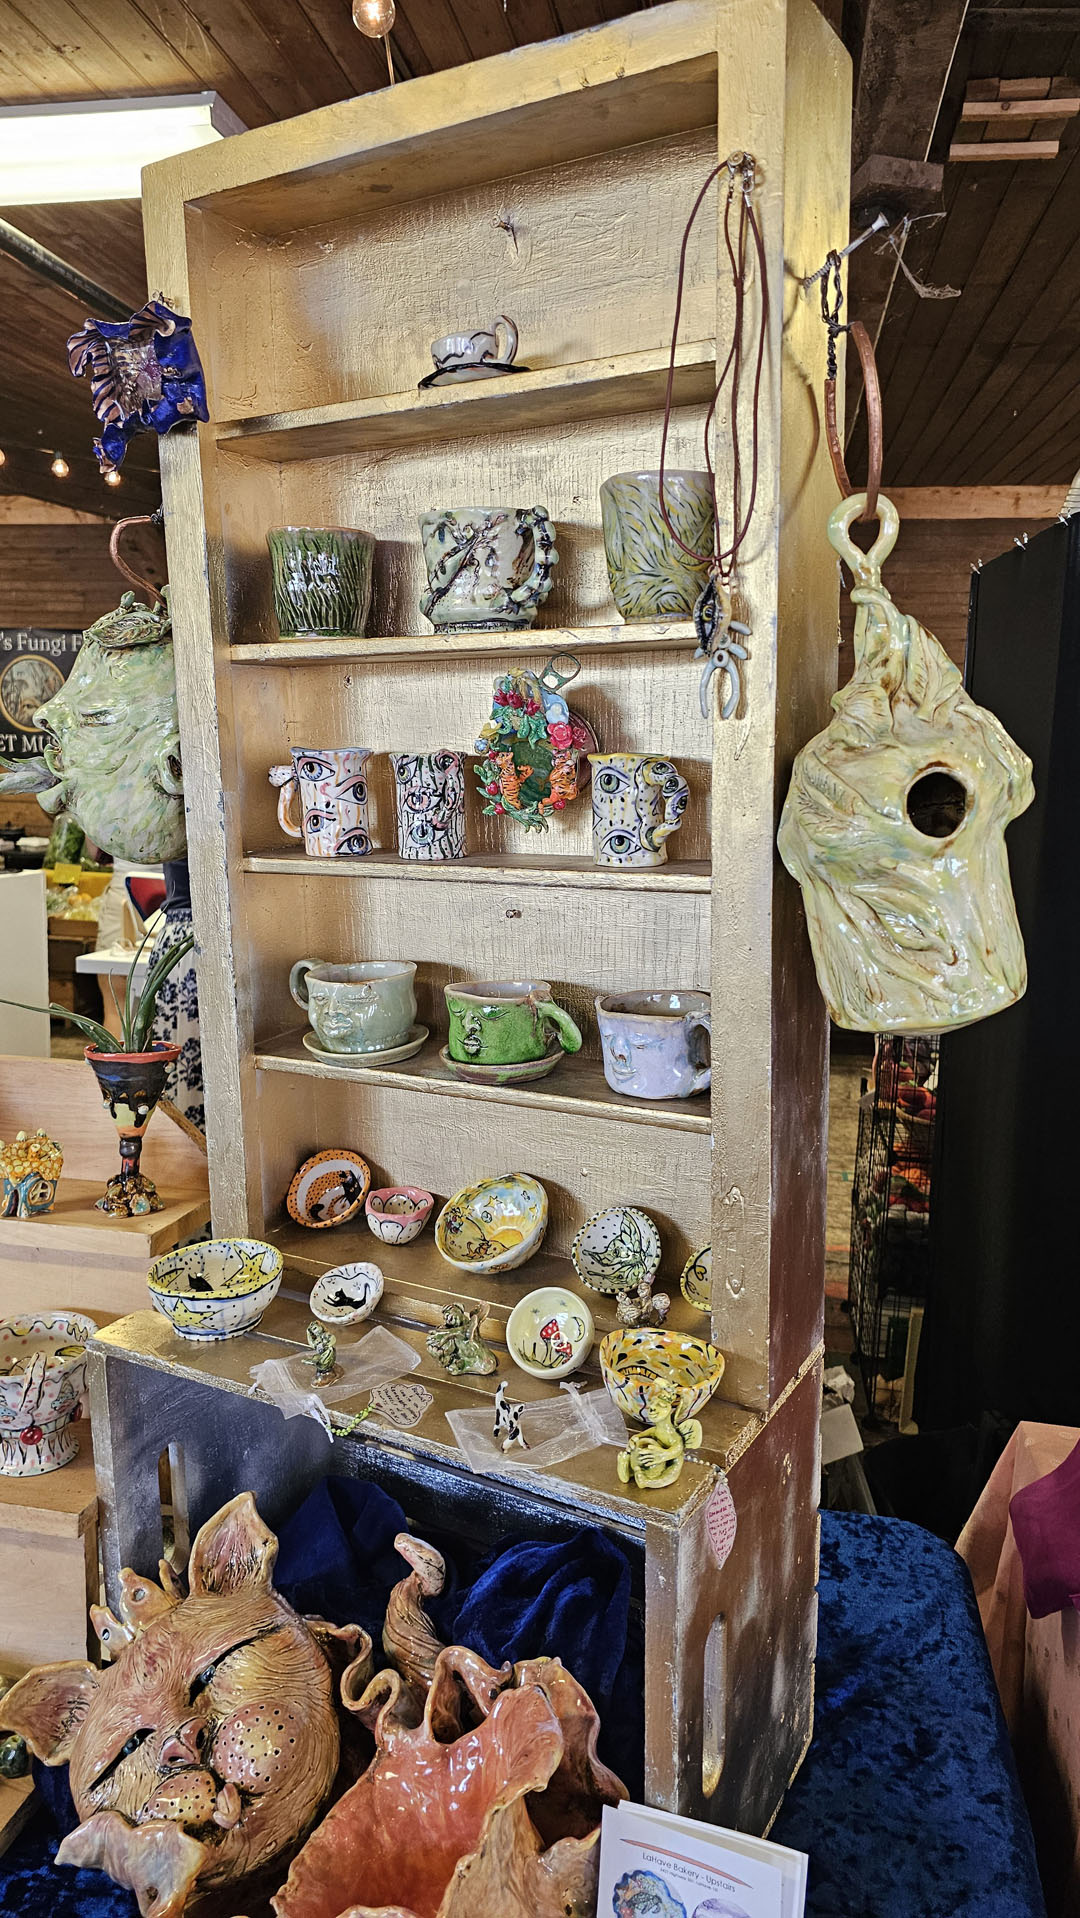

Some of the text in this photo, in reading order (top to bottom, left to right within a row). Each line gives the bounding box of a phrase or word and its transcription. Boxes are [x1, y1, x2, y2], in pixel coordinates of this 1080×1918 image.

[0, 631, 83, 657] 's Fungi F
[642, 1852, 671, 1868] LaHave
[673, 1863, 700, 1880] Bakery
[706, 1875, 736, 1892] Upstairs
